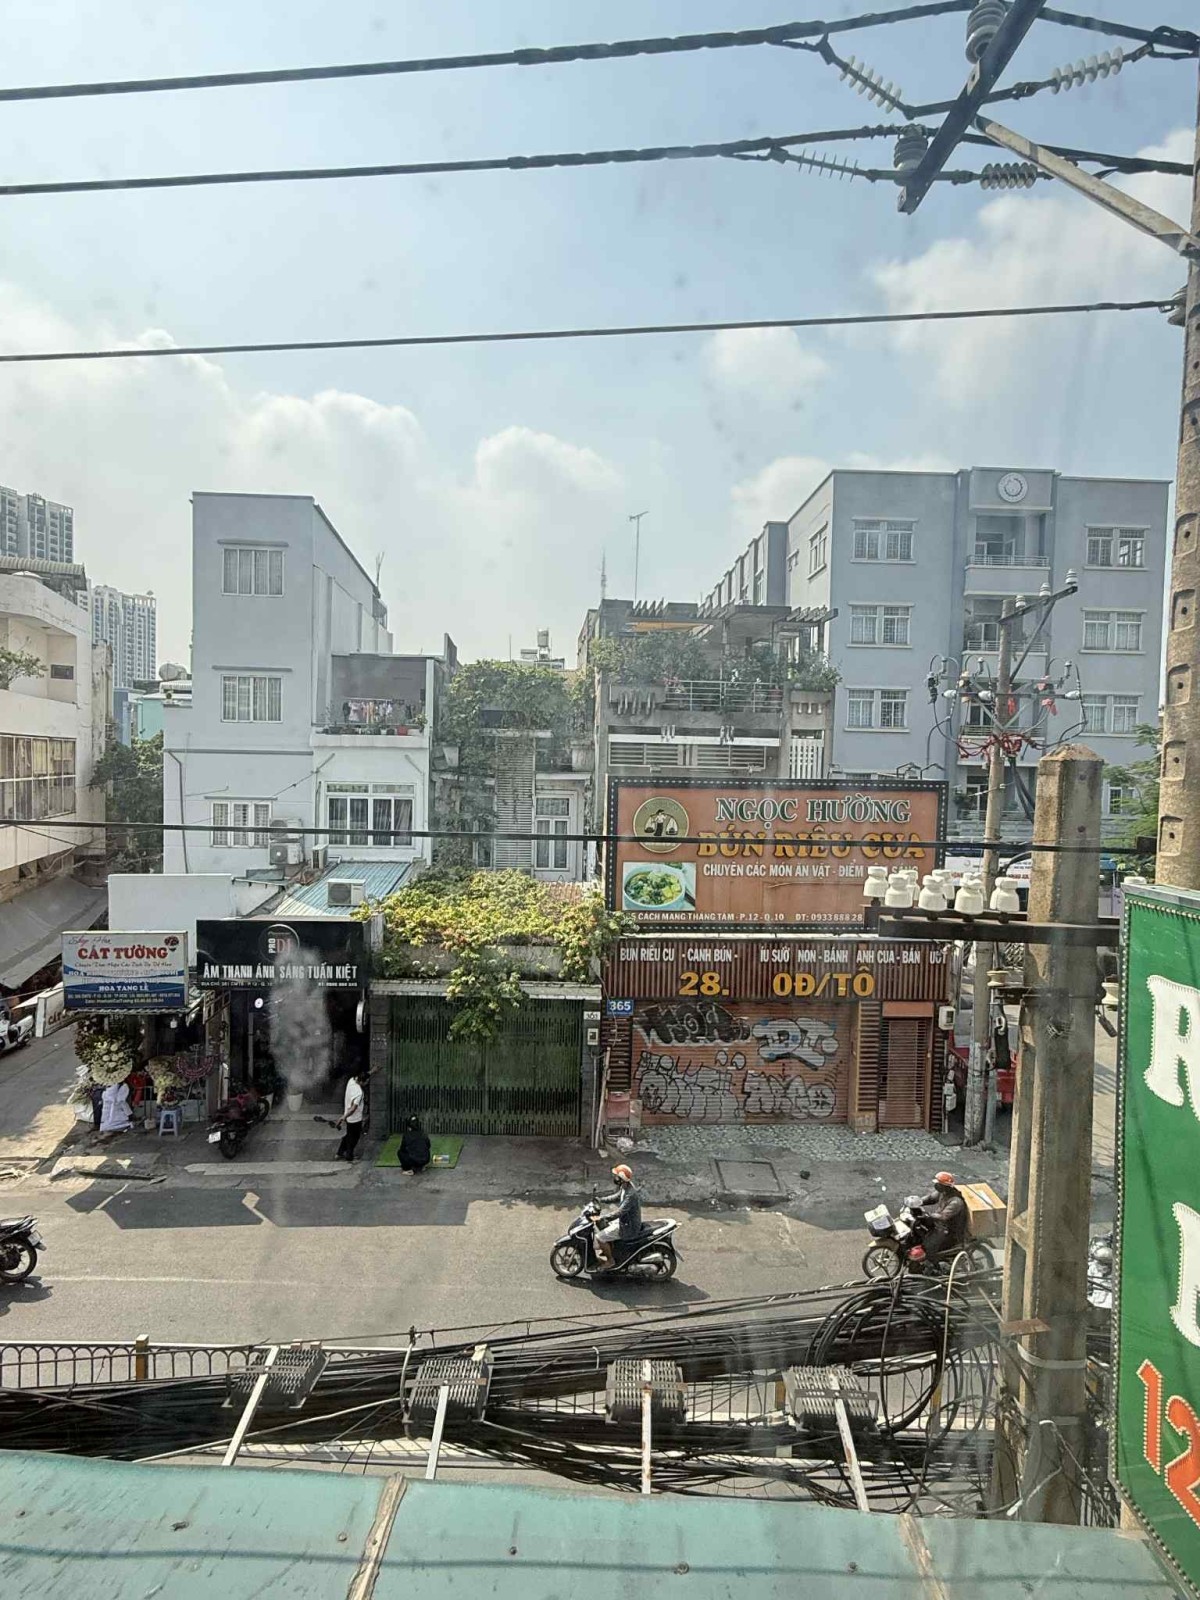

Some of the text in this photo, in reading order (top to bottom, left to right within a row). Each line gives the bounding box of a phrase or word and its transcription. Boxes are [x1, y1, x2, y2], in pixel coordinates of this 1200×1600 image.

[715, 793, 911, 830] NGỌC HƯỜNG
[697, 824, 926, 859] BÚN RIÊU CUA
[703, 861, 744, 876] CHUYÊN
[746, 862, 767, 877] CÁC
[769, 862, 793, 877] MÓN
[687, 947, 712, 962] CANH
[713, 945, 732, 962] BÚN
[797, 949, 816, 963] NON
[823, 946, 849, 963] BÁNH
[877, 949, 895, 964] CUA
[203, 962, 220, 978] ÂM
[222, 965, 252, 978] THANH
[255, 962, 275, 978] ÁNH
[678, 970, 730, 997] 28.
[608, 1001, 631, 1011] 365
